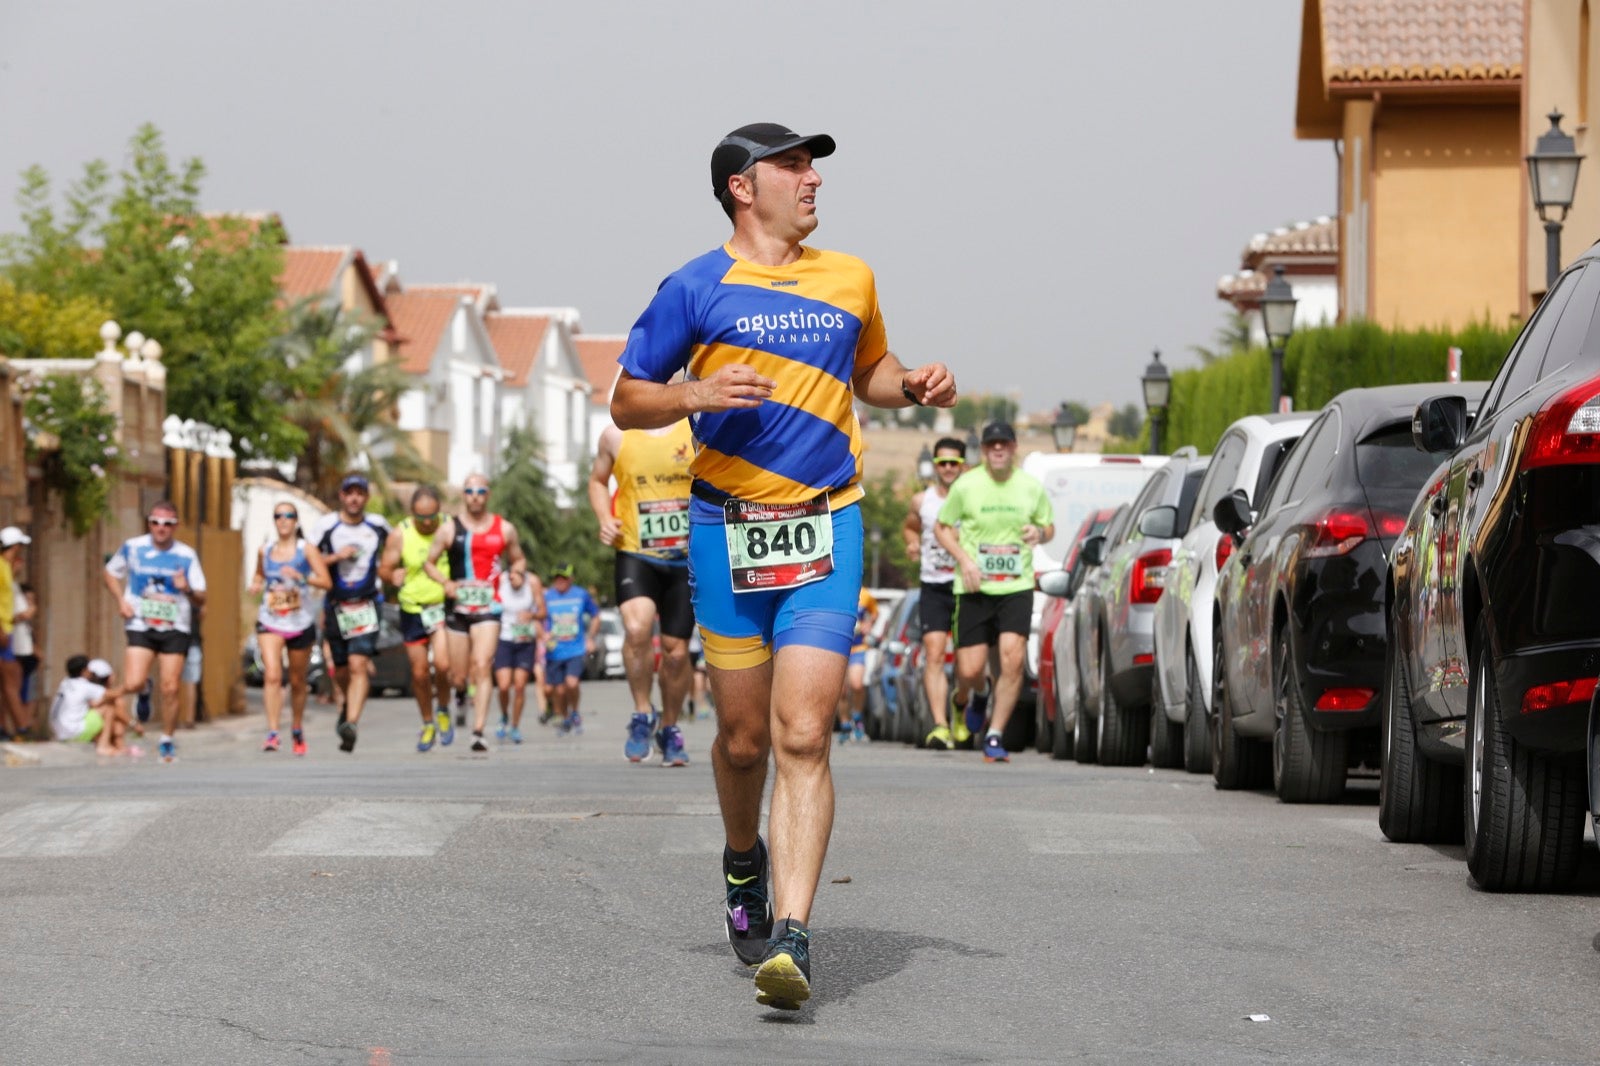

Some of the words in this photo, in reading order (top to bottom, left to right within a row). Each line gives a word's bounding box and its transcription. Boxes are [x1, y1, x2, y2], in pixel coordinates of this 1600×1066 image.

[736, 309, 844, 338] agustinos
[757, 333, 831, 344] GRANADA
[747, 522, 816, 560] 840
[985, 556, 1016, 571] 690
